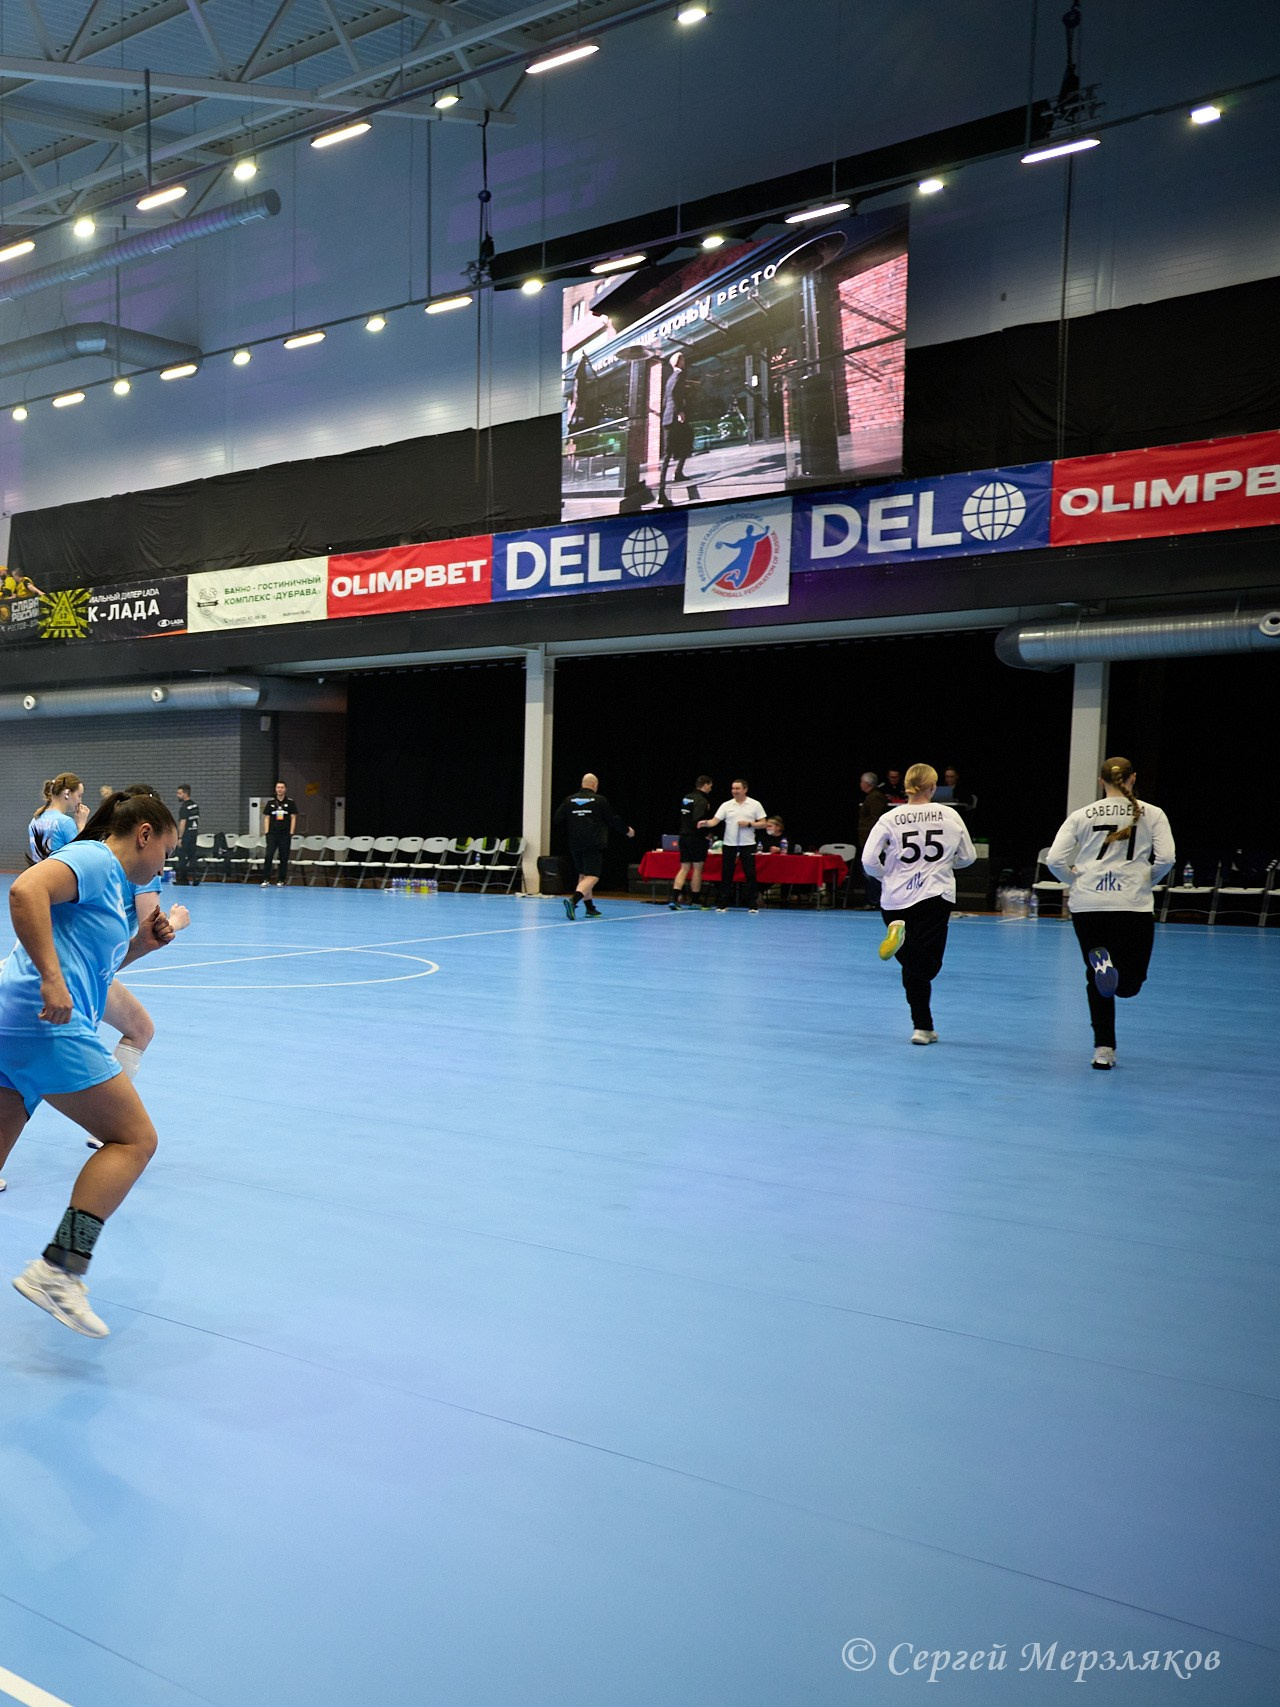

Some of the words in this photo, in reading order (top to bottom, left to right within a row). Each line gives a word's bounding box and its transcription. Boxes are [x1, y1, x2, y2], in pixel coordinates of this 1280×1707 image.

[224, 585, 251, 595] БАННО
[258, 575, 321, 591] ГОСТИНИЧНЫЙ
[331, 559, 487, 598] OLIMPBET
[711, 587, 743, 598] HANDBALL
[744, 565, 776, 595] FEDERATION
[89, 592, 120, 603] ИАЛЬНЫЙ
[121, 589, 142, 601] ДИЛЕР
[142, 588, 160, 597] LADA
[224, 593, 271, 605] КОМПЛЕКС
[87, 599, 160, 623] К-ЛАДА
[894, 811, 944, 825] СОСУЛИНА
[900, 829, 944, 864] 55
[1092, 824, 1137, 861] 71
